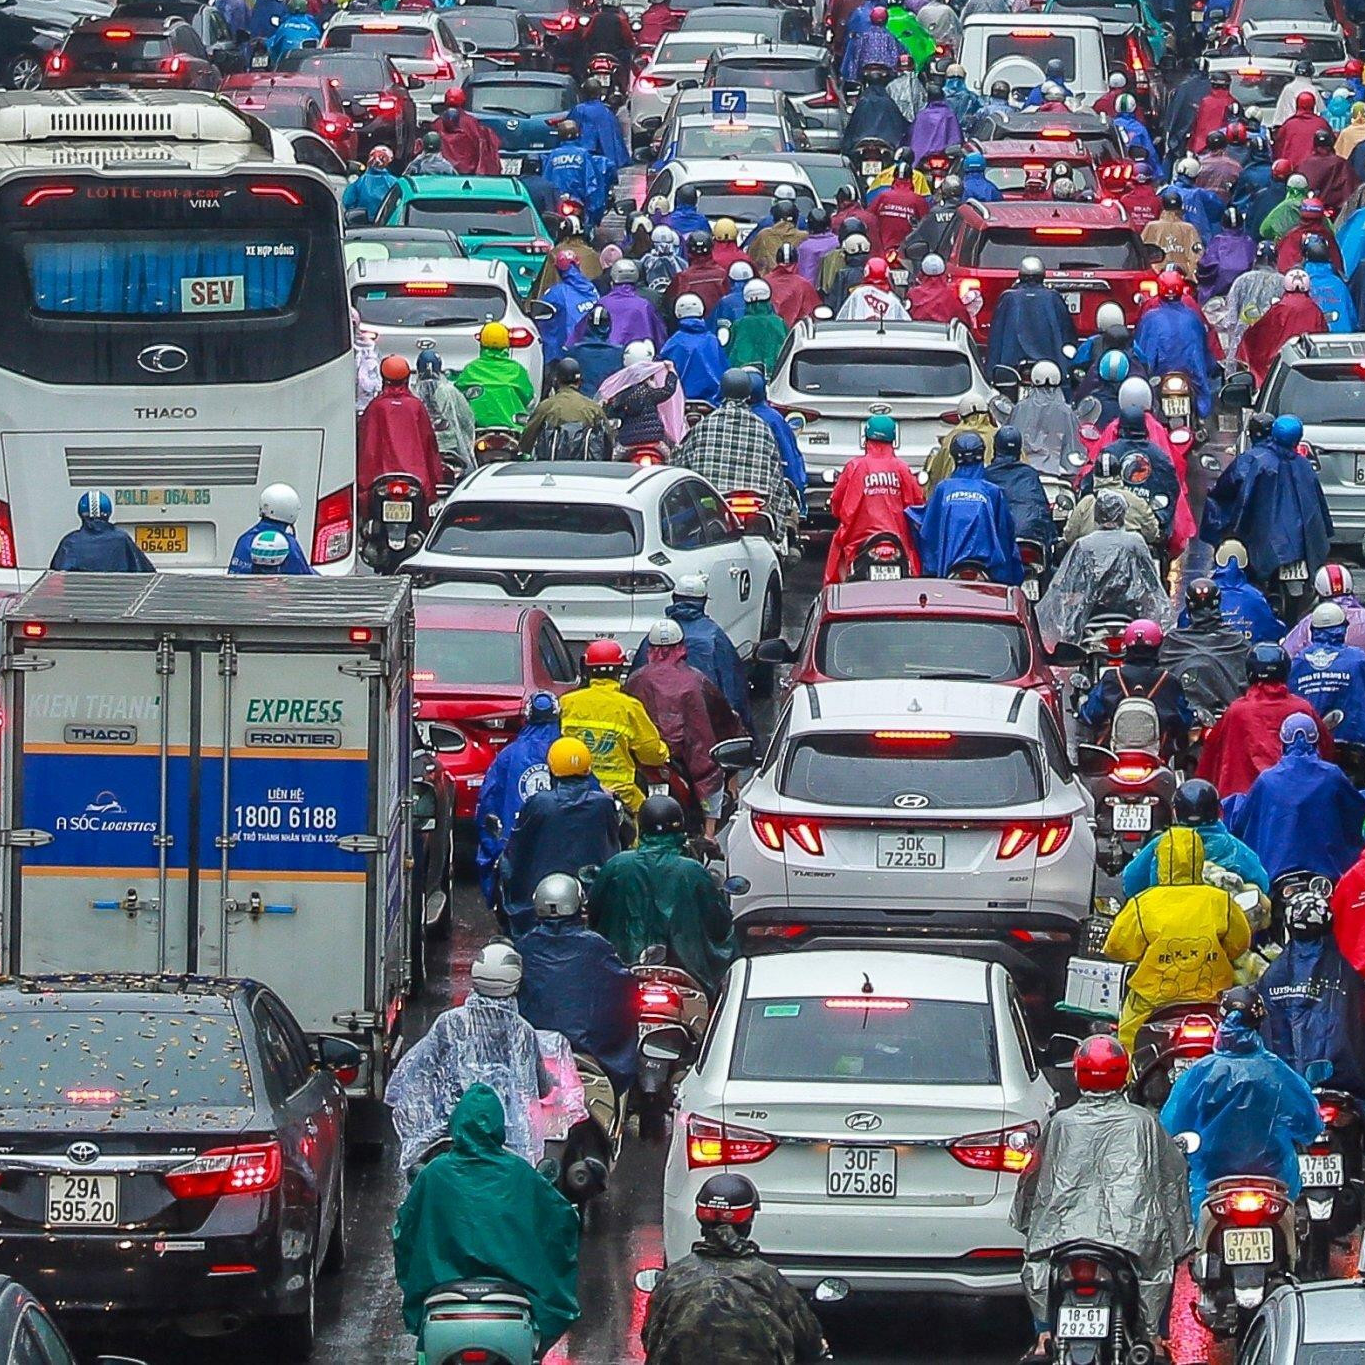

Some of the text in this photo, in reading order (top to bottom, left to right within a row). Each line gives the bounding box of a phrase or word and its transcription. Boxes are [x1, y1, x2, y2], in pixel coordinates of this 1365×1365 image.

[86, 187, 142, 199] LOTTE
[190, 199, 221, 208] VINA
[190, 280, 235, 306] SEV
[134, 407, 198, 419] THACO
[163, 488, 211, 505] 064.85
[146, 527, 177, 540] 29LD
[140, 540, 183, 552] 064.85
[245, 698, 344, 724] EXPRESS
[70, 728, 131, 741] THACO
[250, 732, 336, 745] FRONTIER
[268, 786, 287, 801] LIÊN
[56, 813, 157, 833] A SÓC LOGISTICS
[235, 805, 337, 829] 1800 6188
[896, 836, 925, 852] 30K
[884, 851, 937, 867] 722.50
[792, 869, 837, 878] TUCSON
[1158, 952, 1218, 965] BE AR
[843, 1149, 880, 1171] 30F
[63, 1177, 102, 1199] 29A
[828, 1171, 894, 1196] 075.86
[49, 1200, 115, 1222] 595.20
[1227, 1246, 1271, 1263] 912.15
